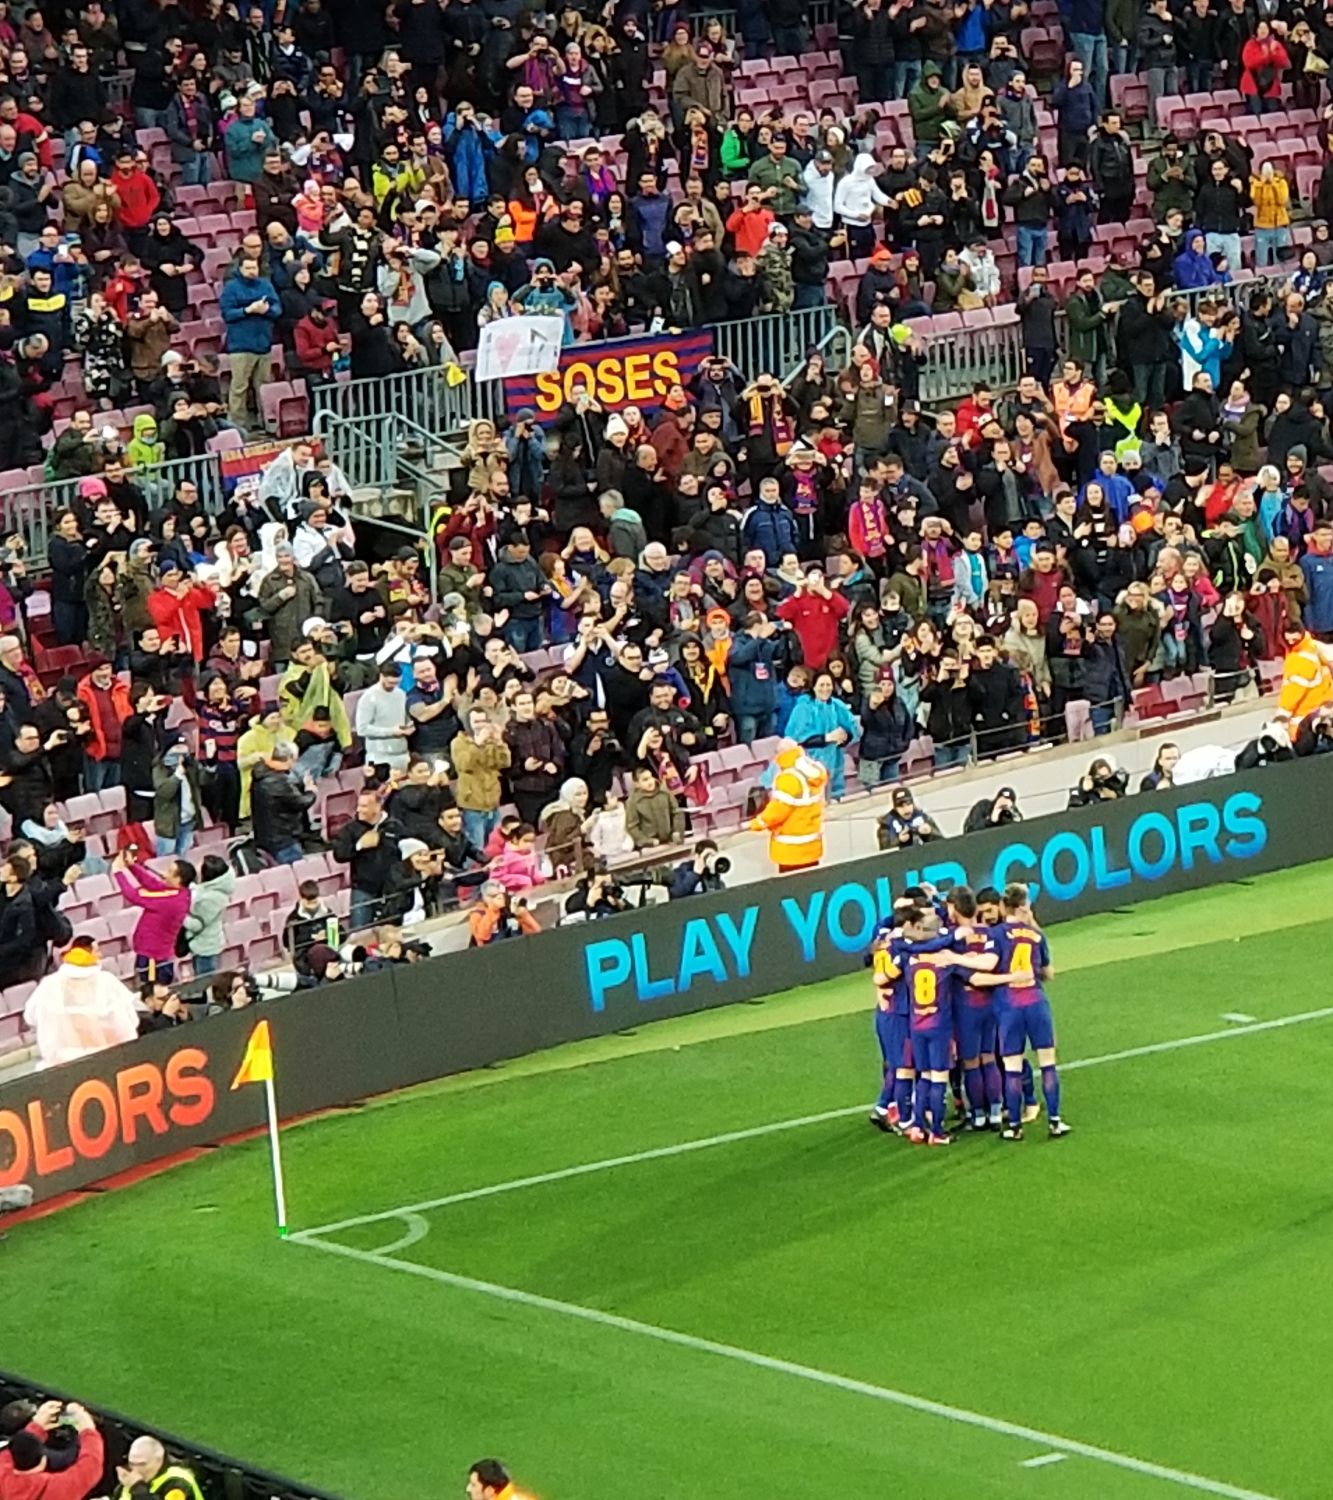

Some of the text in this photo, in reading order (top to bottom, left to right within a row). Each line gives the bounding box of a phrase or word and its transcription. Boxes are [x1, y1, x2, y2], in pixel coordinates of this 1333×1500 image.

[584, 906, 759, 1012] PLAY
[992, 791, 1268, 904] COLORS
[1009, 942, 1034, 977] 4
[914, 968, 937, 1006] 8
